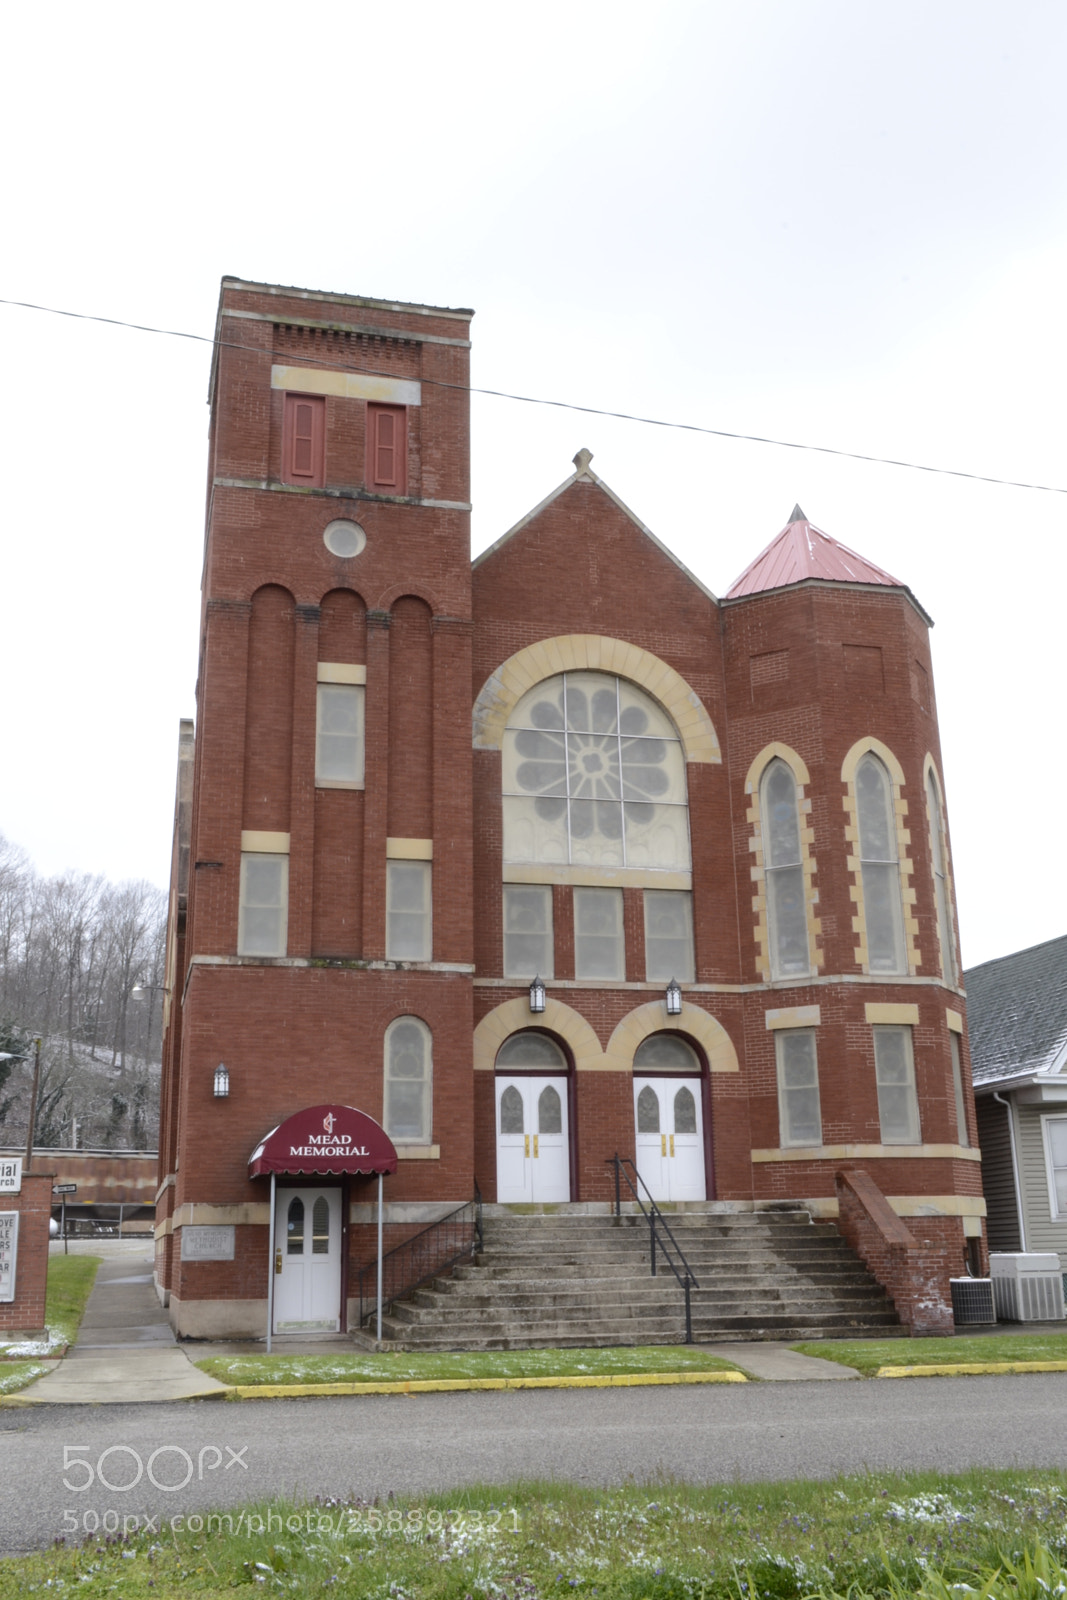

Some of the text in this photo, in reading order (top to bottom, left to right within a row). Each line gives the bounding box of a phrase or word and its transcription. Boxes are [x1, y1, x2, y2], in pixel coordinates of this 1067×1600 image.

[308, 1134, 352, 1145] MEAD
[289, 1146, 370, 1156] MEMORIAL
[0, 1163, 17, 1177] ial
